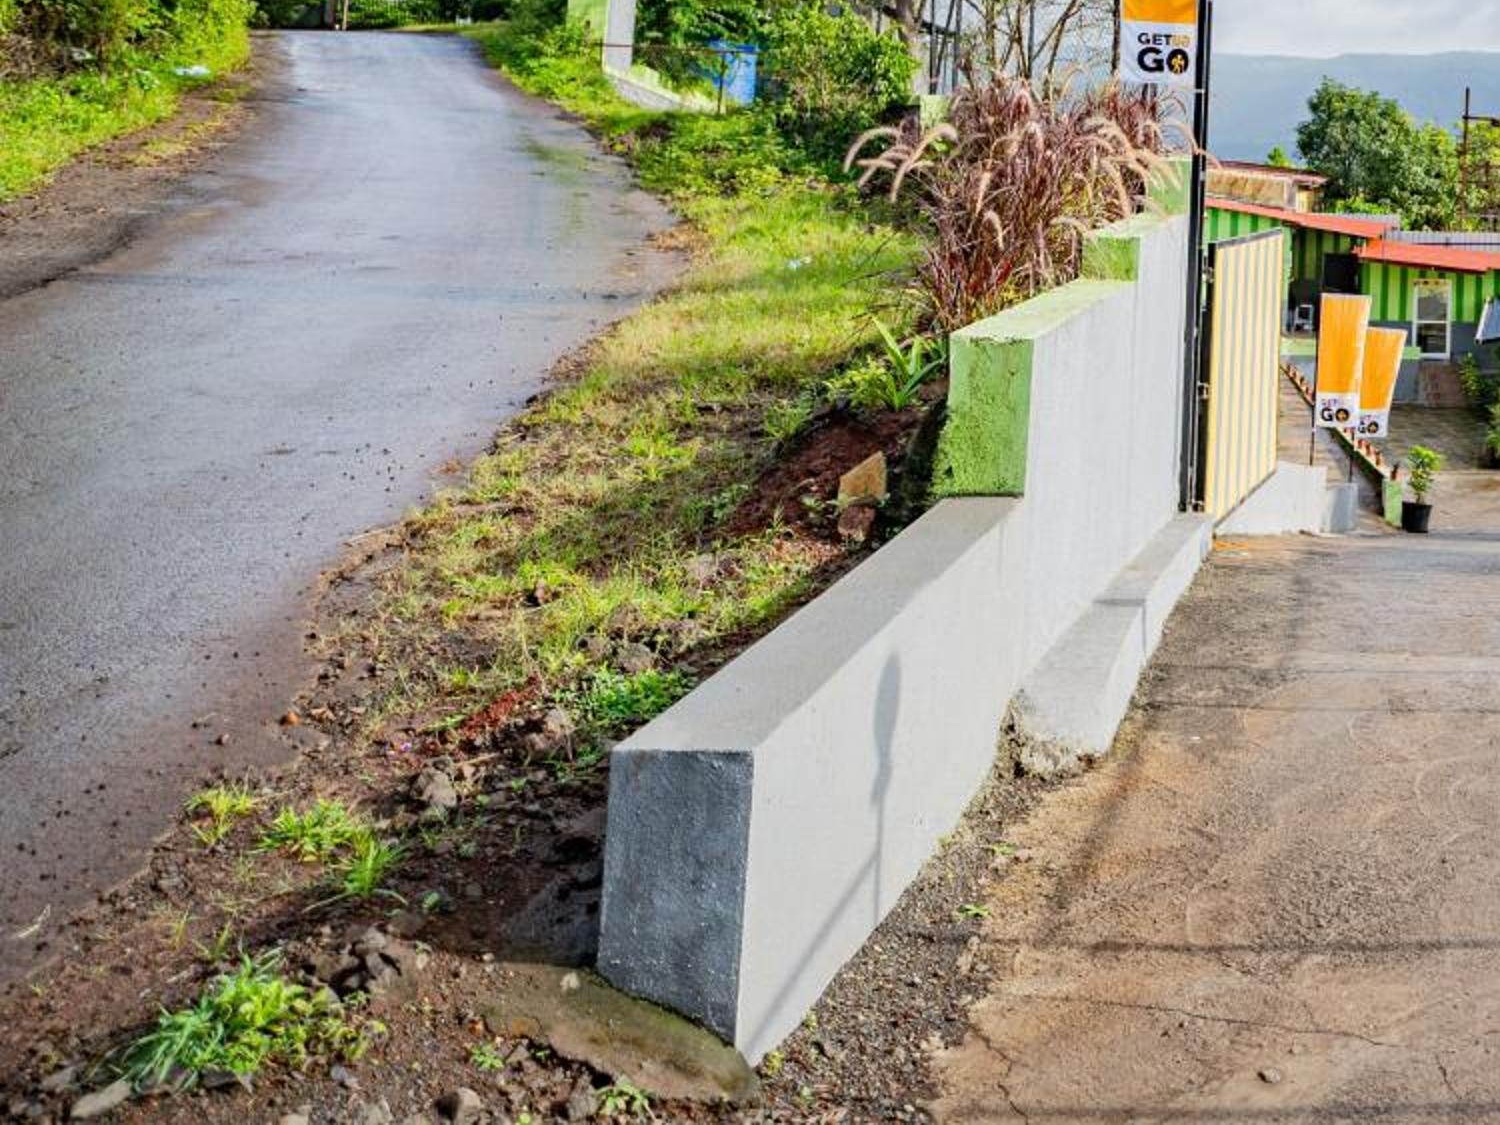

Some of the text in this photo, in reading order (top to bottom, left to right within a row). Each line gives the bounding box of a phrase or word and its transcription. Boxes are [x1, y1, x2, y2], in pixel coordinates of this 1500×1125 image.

[1137, 32, 1171, 45] GET
[1137, 46, 1189, 74] GO
[1321, 407, 1350, 423] GO
